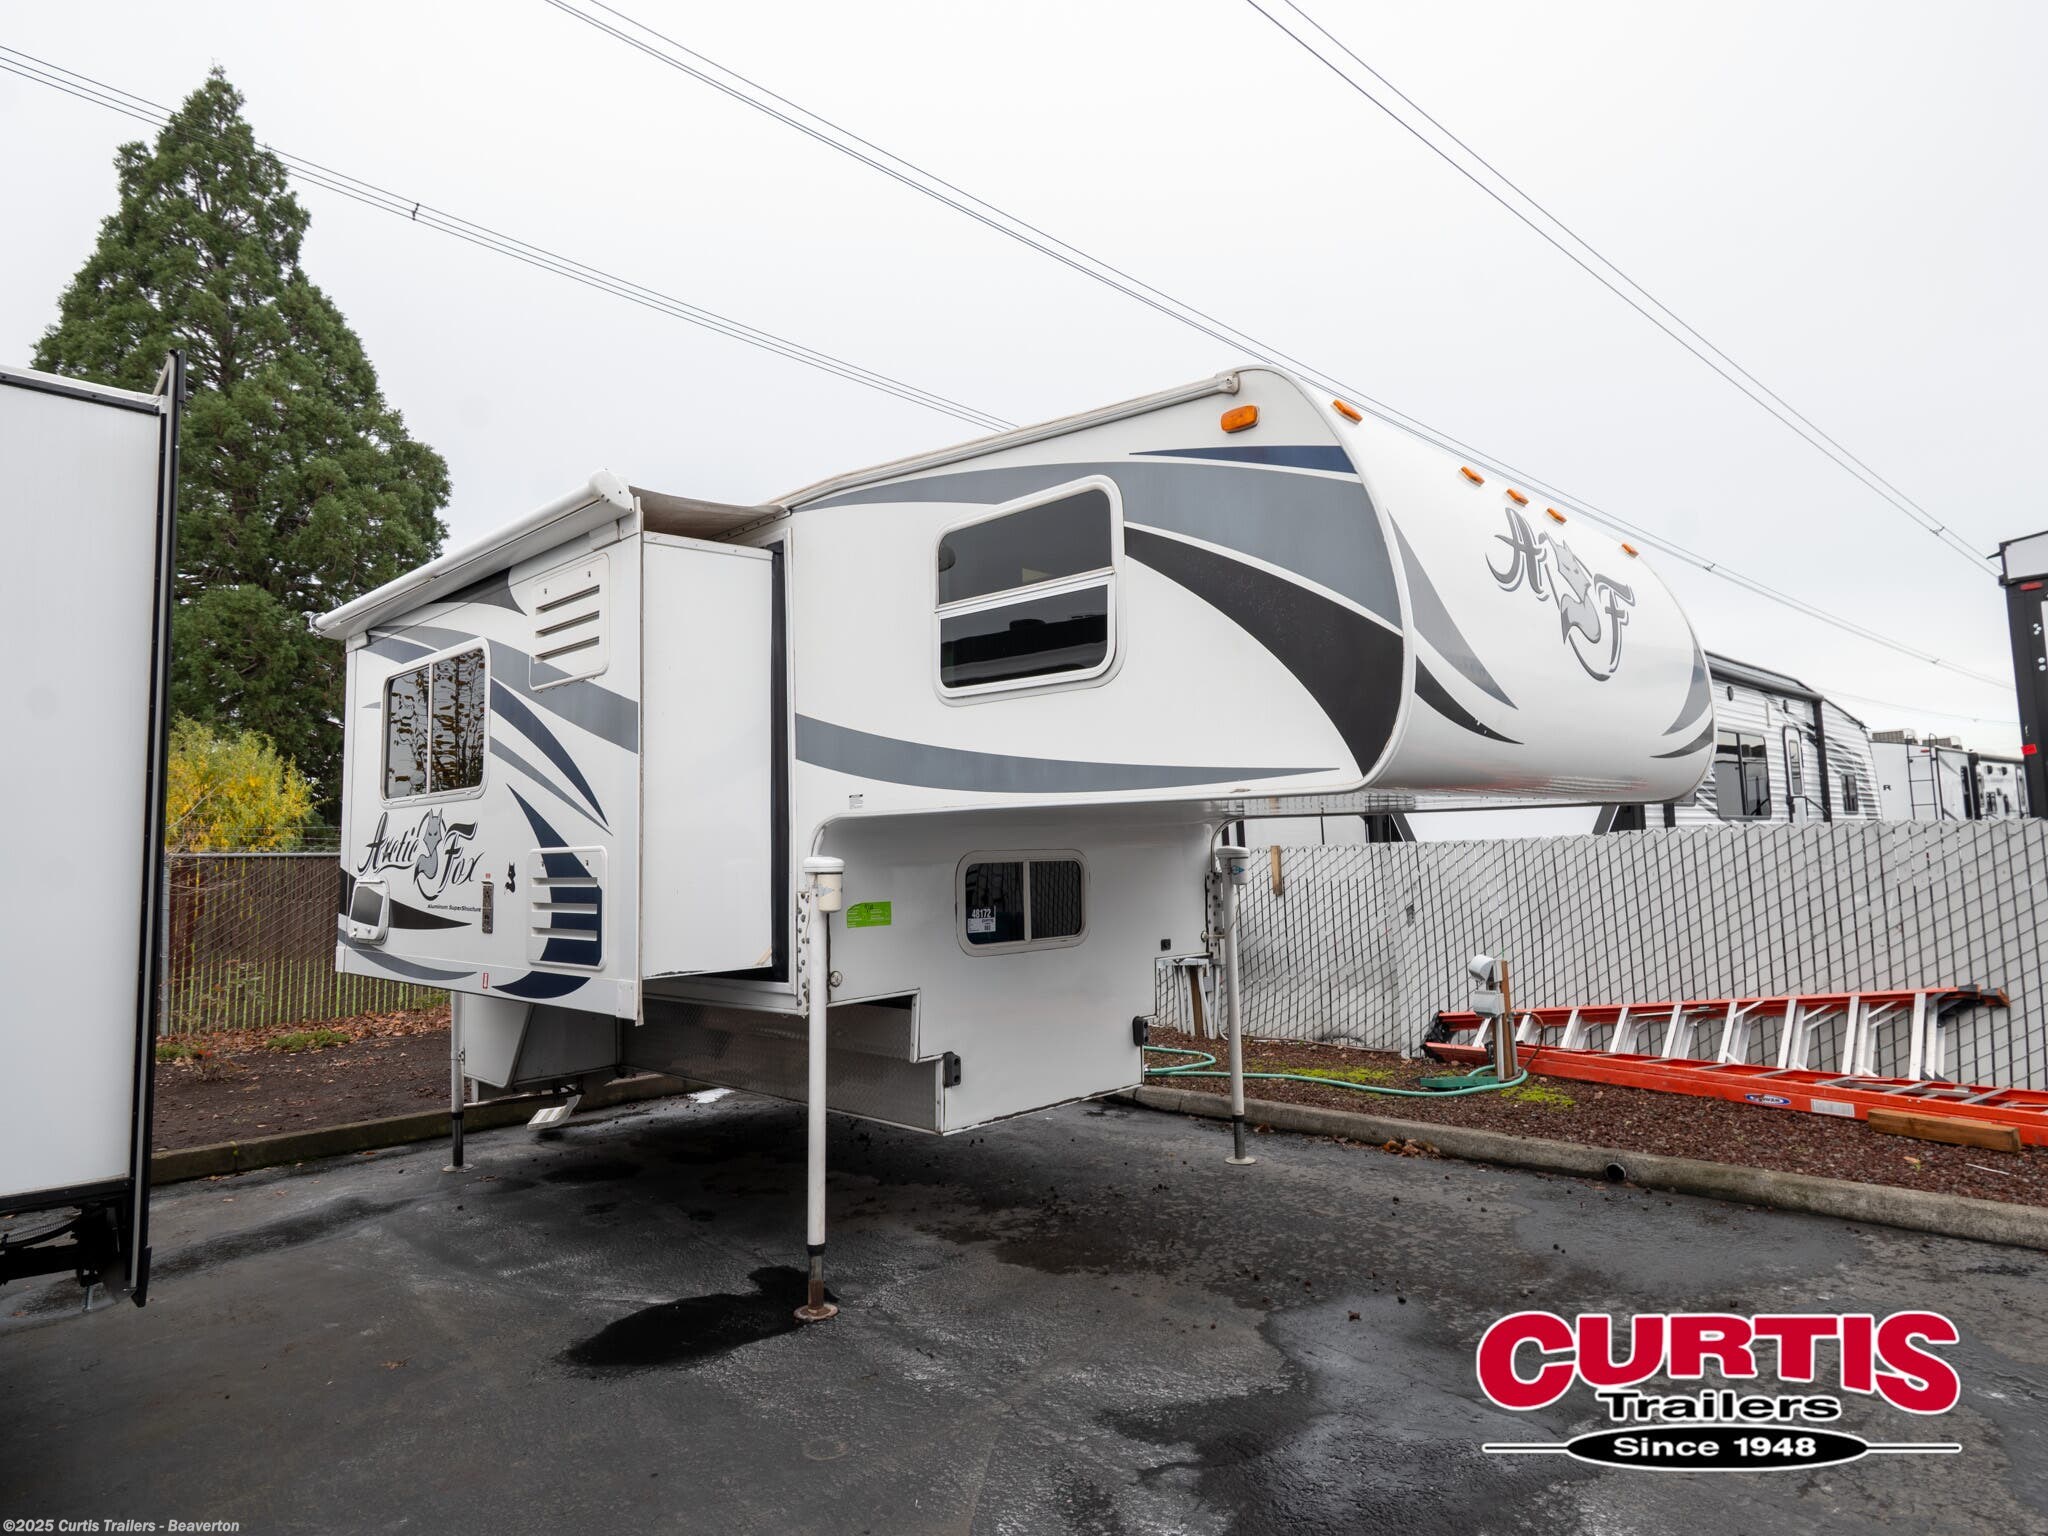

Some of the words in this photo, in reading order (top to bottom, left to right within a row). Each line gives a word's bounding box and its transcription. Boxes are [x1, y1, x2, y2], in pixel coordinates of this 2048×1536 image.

[357, 811, 419, 876] Arctic
[439, 821, 485, 889] Fox
[971, 908, 991, 918] 48172
